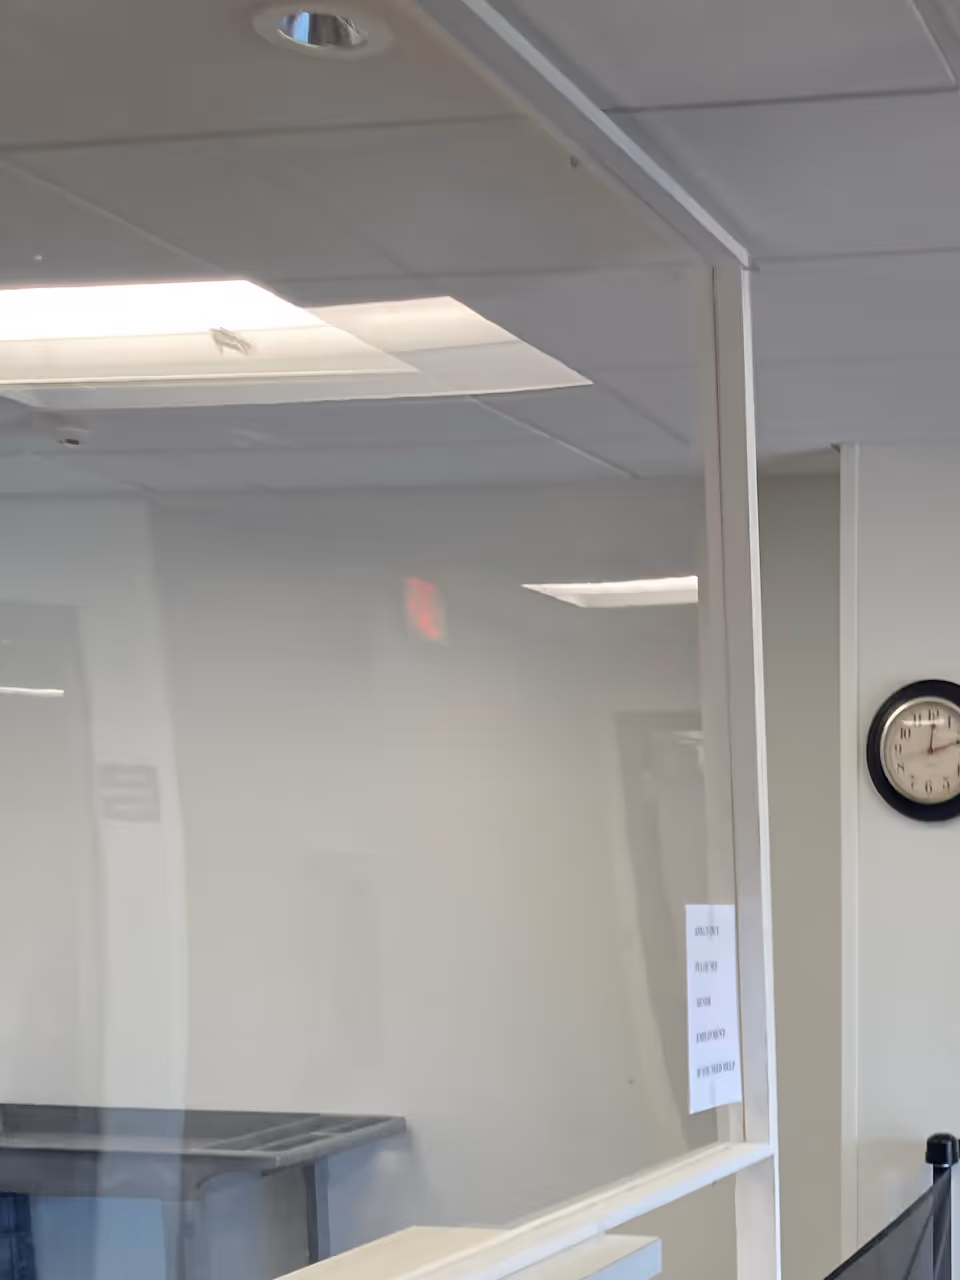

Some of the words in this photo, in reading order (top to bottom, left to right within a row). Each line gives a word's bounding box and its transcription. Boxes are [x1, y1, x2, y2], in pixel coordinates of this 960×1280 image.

[914, 713, 922, 727] 11
[900, 727, 911, 740] 10
[925, 780, 933, 793] 6
